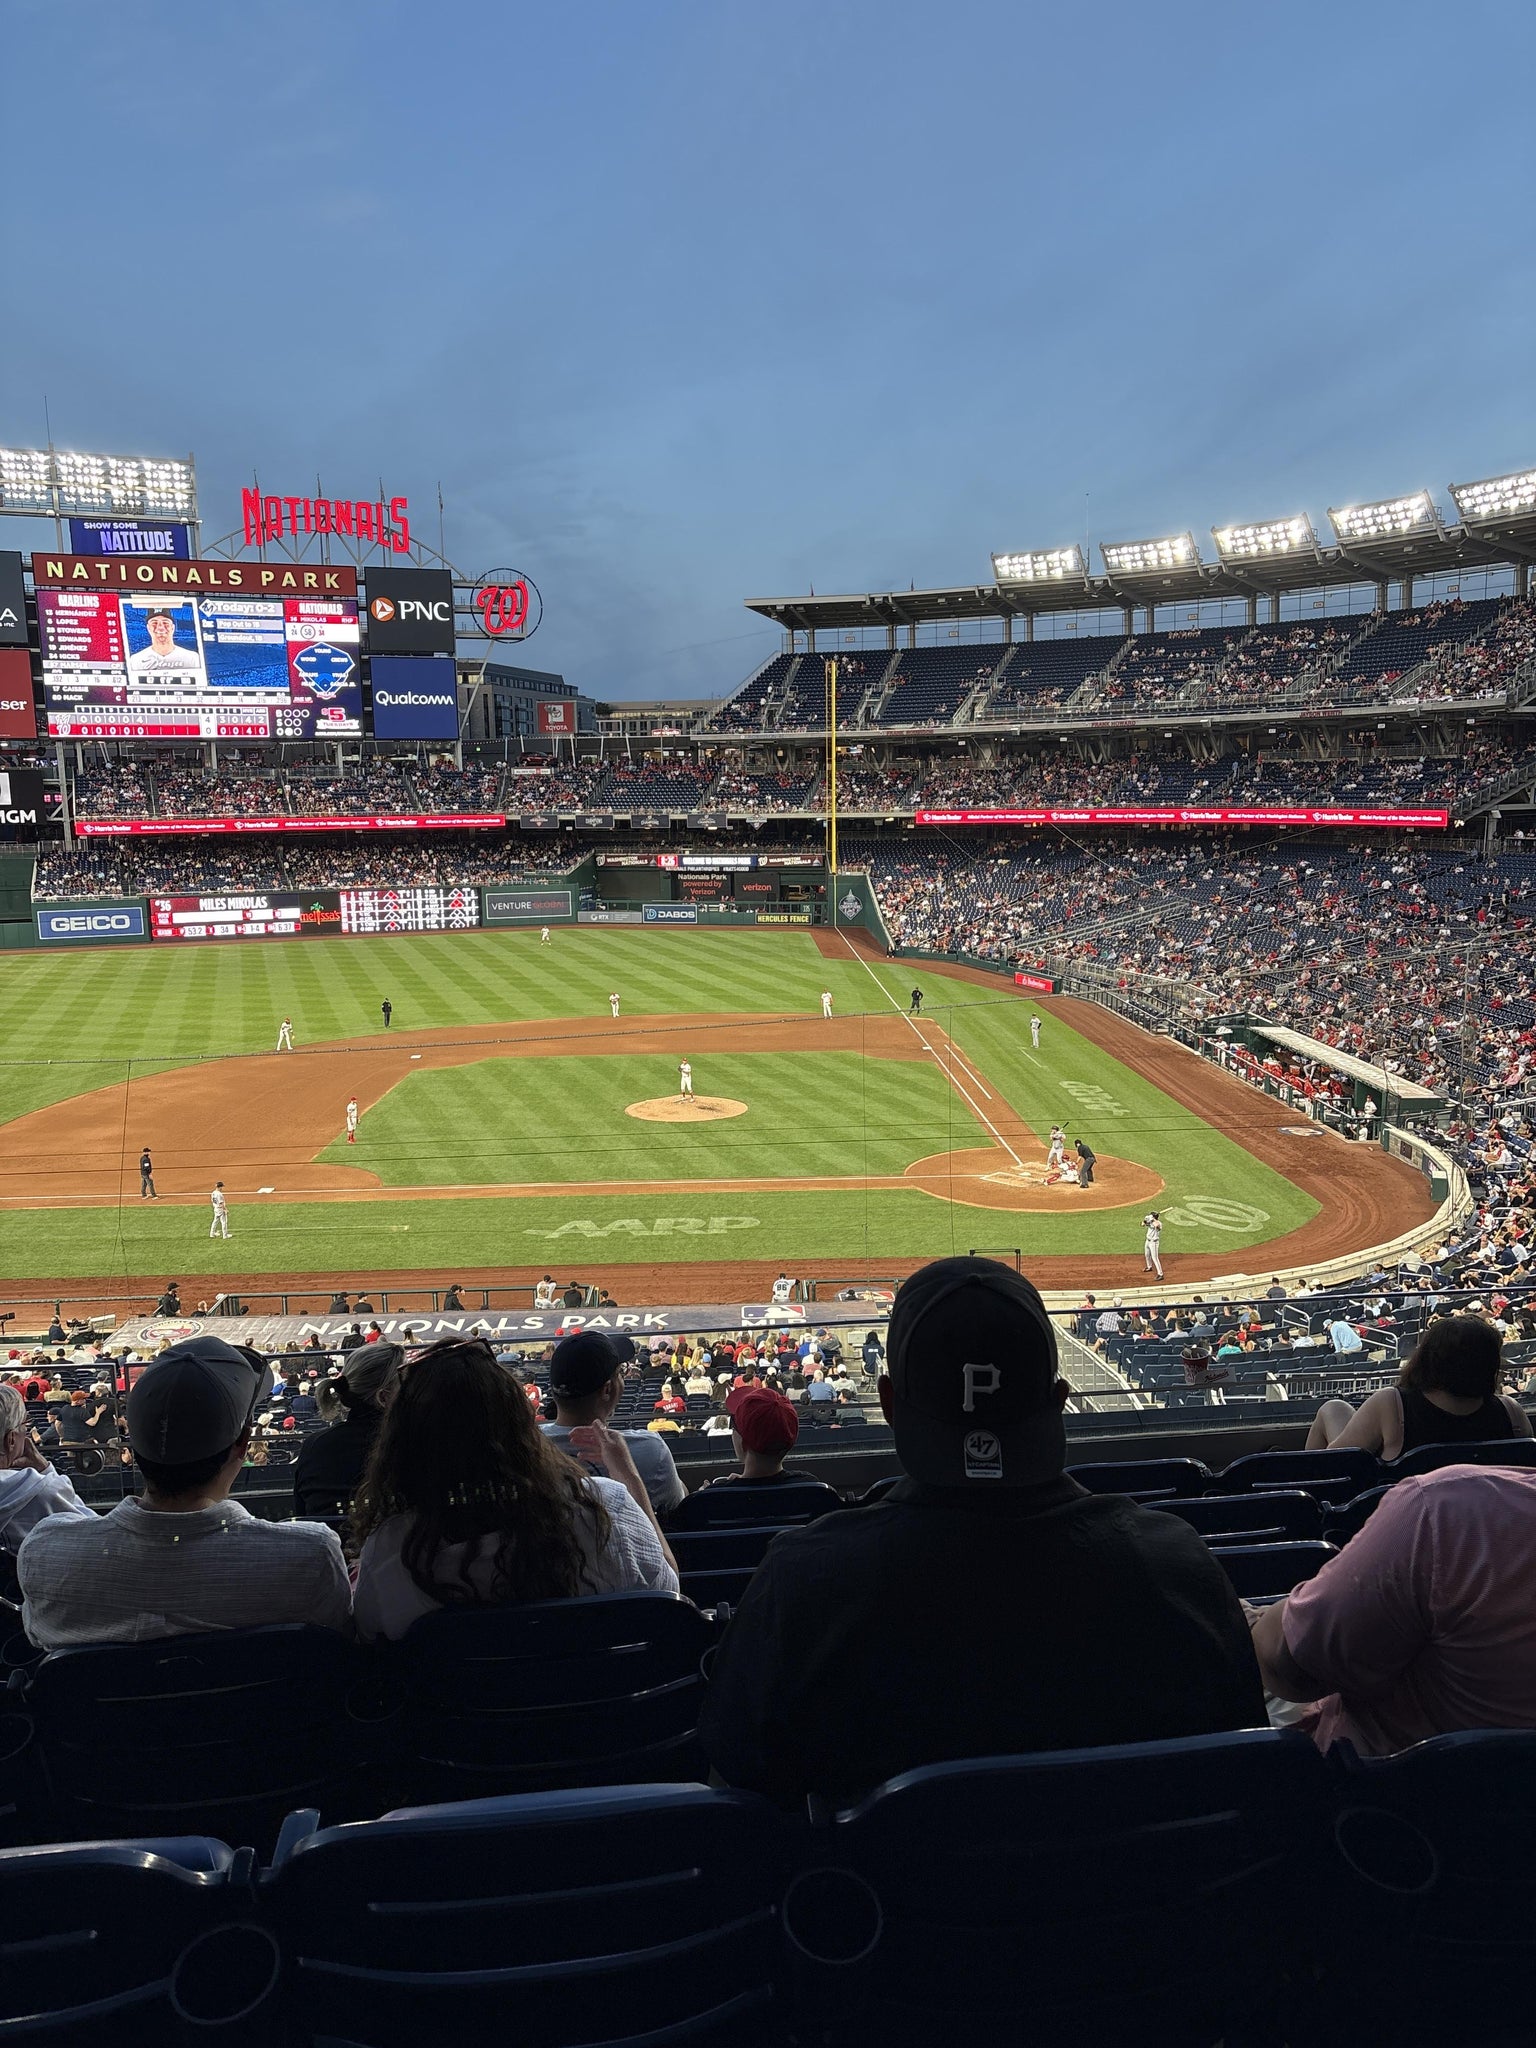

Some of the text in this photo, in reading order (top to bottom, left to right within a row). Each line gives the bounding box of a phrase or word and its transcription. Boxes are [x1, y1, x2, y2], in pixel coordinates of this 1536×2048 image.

[241, 487, 410, 553] NATIONALS
[100, 530, 174, 552] NATITUDE
[46, 561, 340, 590] NATIONALS PARK
[58, 594, 99, 608] MARLINS
[216, 603, 275, 613] Today: 0-2
[299, 603, 343, 615] NATIONALS
[398, 600, 450, 622] PNC
[376, 691, 454, 705] Qualcomm
[200, 898, 227, 910] MILES
[227, 896, 268, 909] MIKOLAS
[50, 914, 130, 931] GEICO
[522, 1216, 760, 1239] AARP
[298, 1312, 670, 1338] NATIONALS PARK
[963, 1363, 1000, 1412] P
